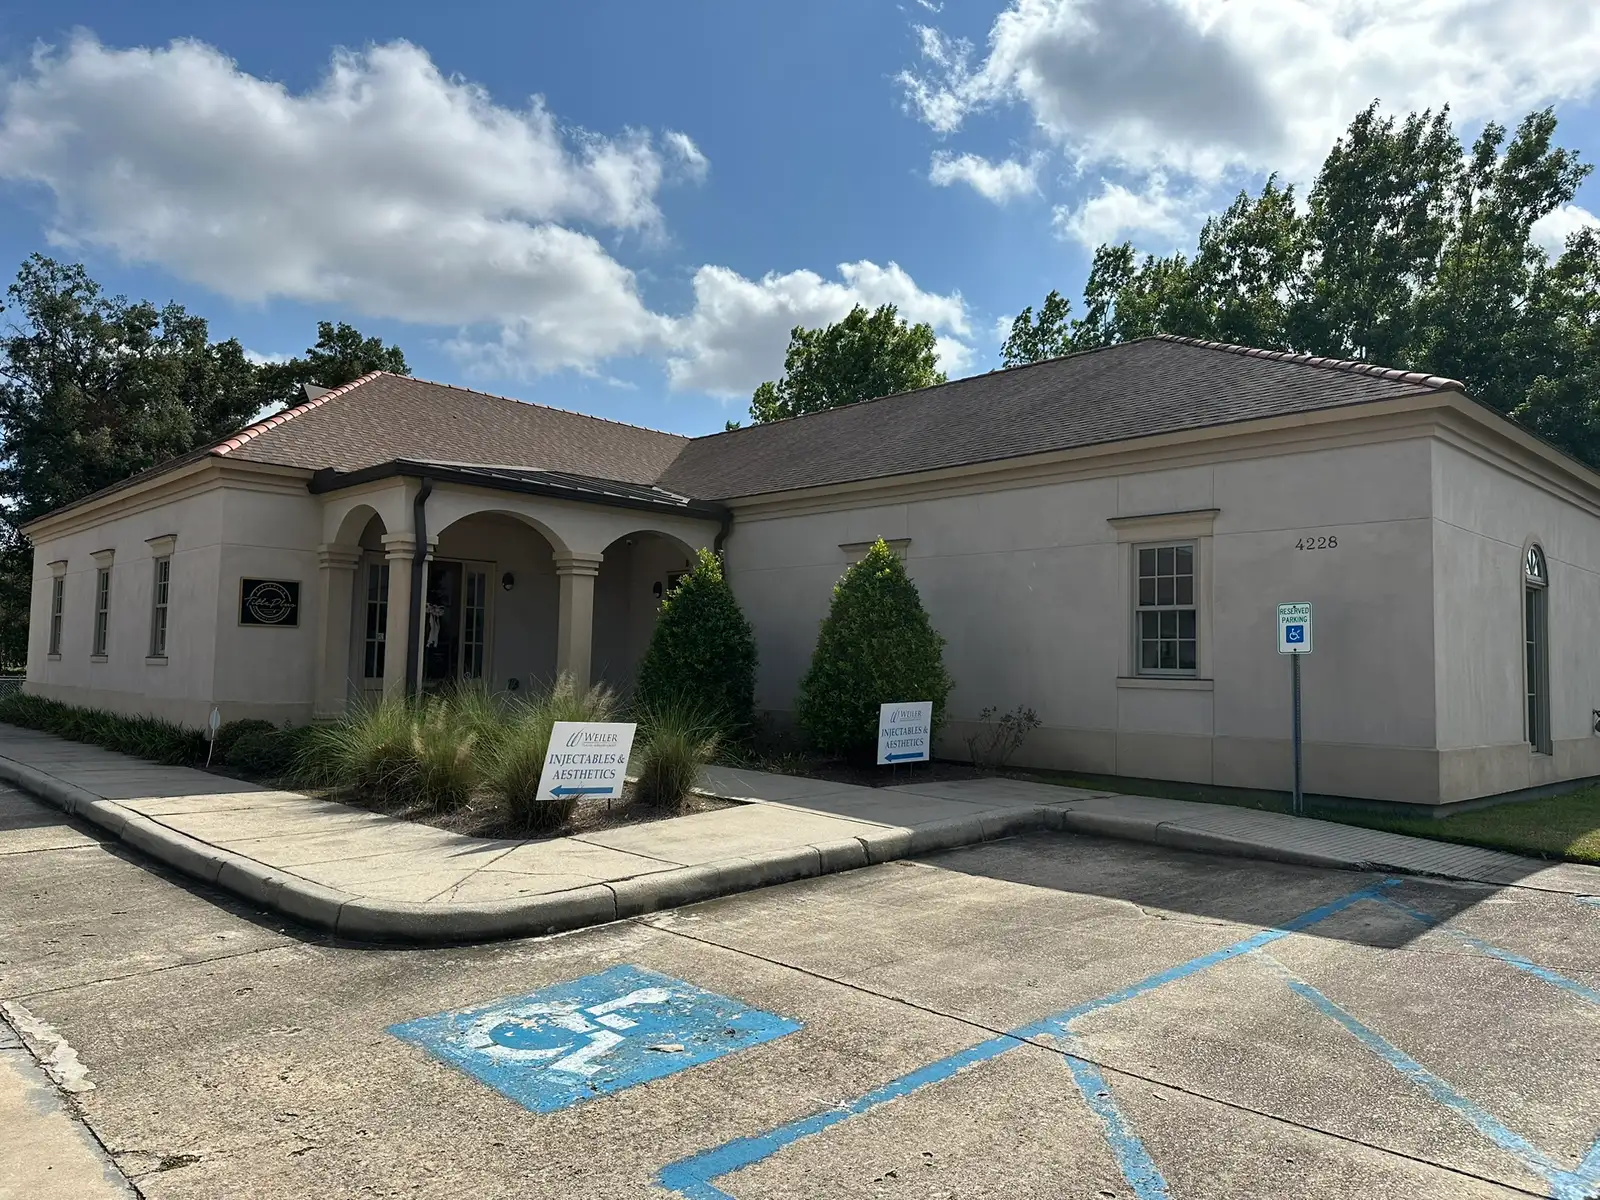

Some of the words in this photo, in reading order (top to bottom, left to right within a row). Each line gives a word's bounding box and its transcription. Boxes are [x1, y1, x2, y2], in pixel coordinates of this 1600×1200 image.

[1294, 535, 1338, 550] 4228
[1280, 606, 1309, 615] RESERVED
[900, 710, 922, 718] WEILER
[584, 732, 618, 742] WEILER
[881, 726, 922, 738] INJECTABLES
[923, 725, 928, 734] &
[885, 738, 924, 749] AESTHETICS
[549, 753, 616, 766] INJECTABLES
[617, 754, 625, 764] &
[552, 769, 616, 780] AESTHETICS
